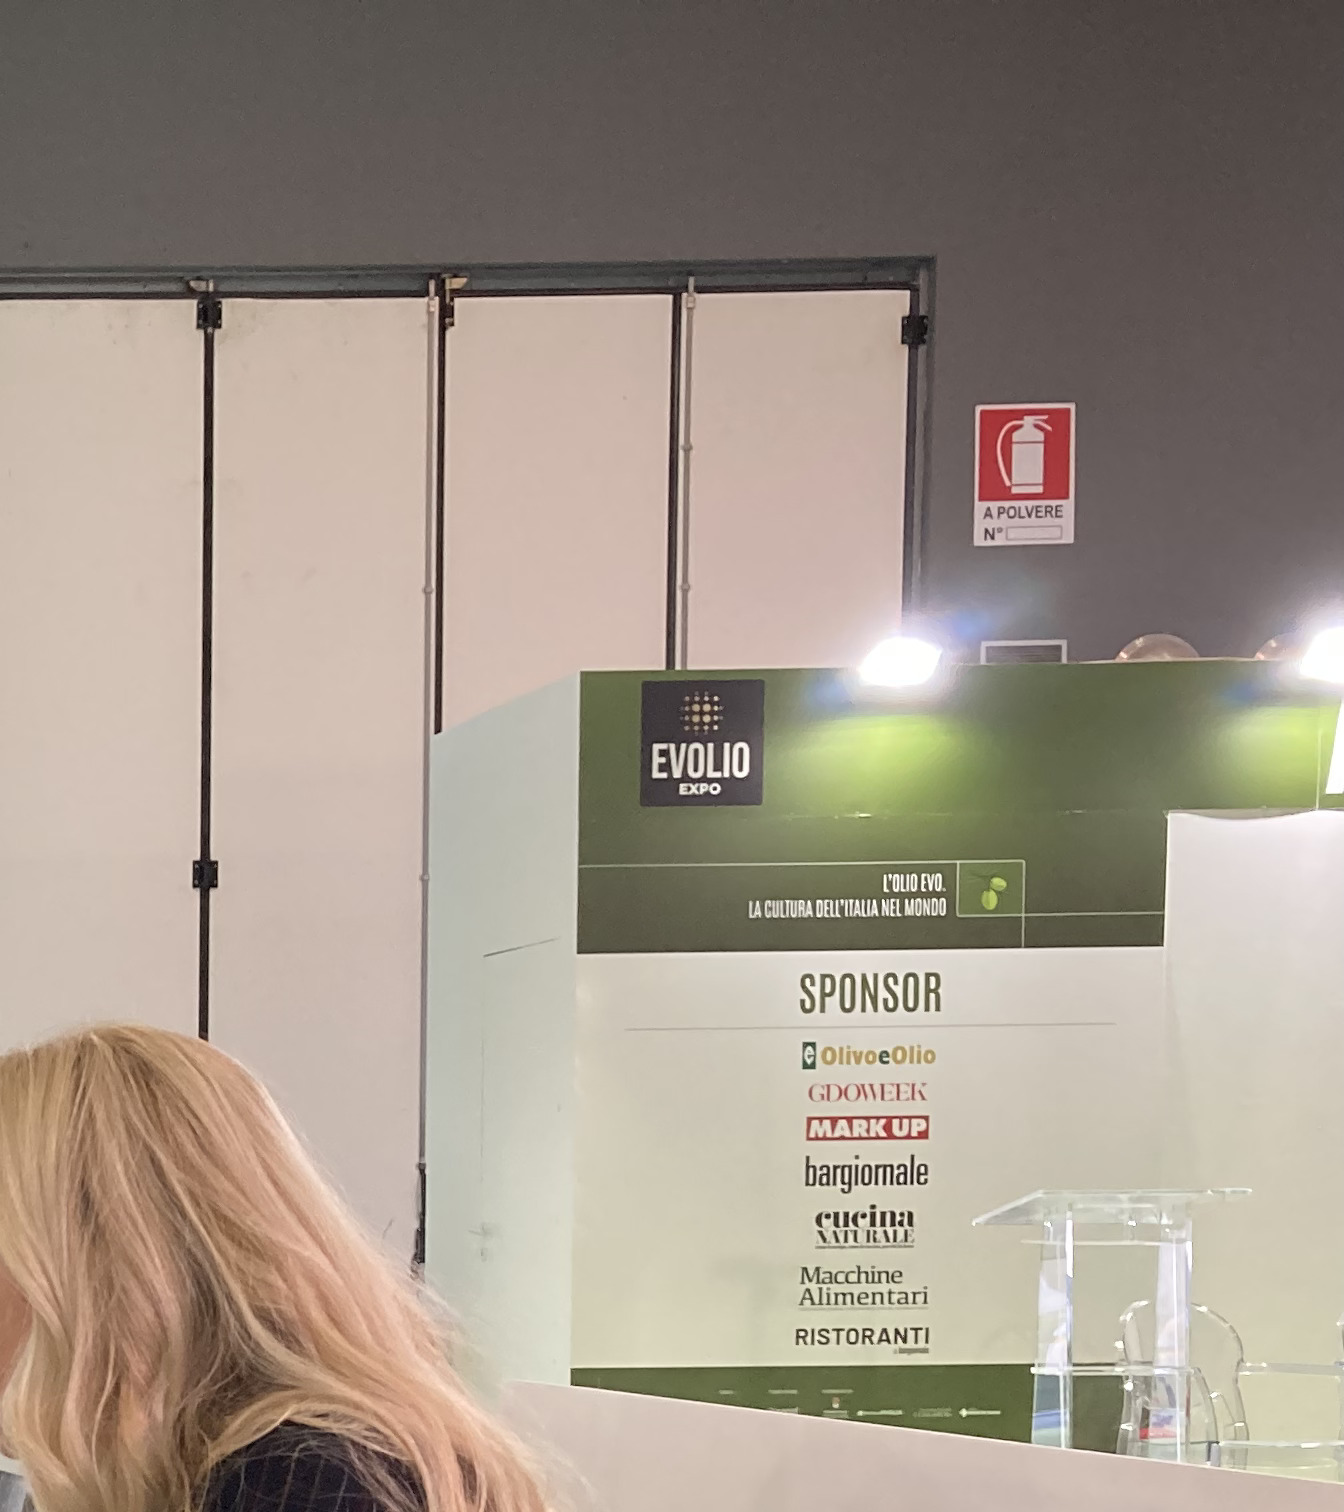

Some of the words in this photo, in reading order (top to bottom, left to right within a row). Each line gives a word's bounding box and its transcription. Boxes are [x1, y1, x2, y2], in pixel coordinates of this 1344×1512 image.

[983, 506, 993, 519] A
[997, 505, 1064, 519] POLVERE
[651, 742, 750, 779] EVOLIO
[678, 782, 721, 795] EXPO
[883, 873, 918, 893] L'OLIO
[920, 873, 946, 892] EVO.
[748, 900, 761, 918] LA
[764, 899, 813, 918] CULTURA
[815, 899, 879, 918] DELL'ITALIA
[881, 898, 902, 917] NEL
[904, 897, 946, 916] MONDO
[800, 972, 941, 1014] SPONSOR
[820, 1044, 937, 1066] OlivoeOlio
[808, 1082, 928, 1102] GDOWEEK
[808, 1118, 888, 1138] MARK
[891, 1117, 928, 1138] UP
[805, 1154, 929, 1194] bargiornale
[815, 1204, 914, 1228] cucina
[815, 1229, 915, 1244] NATURALE
[800, 1265, 904, 1285] Macchine
[798, 1285, 929, 1306] Alimentari
[795, 1327, 930, 1345] RISTORANTI
